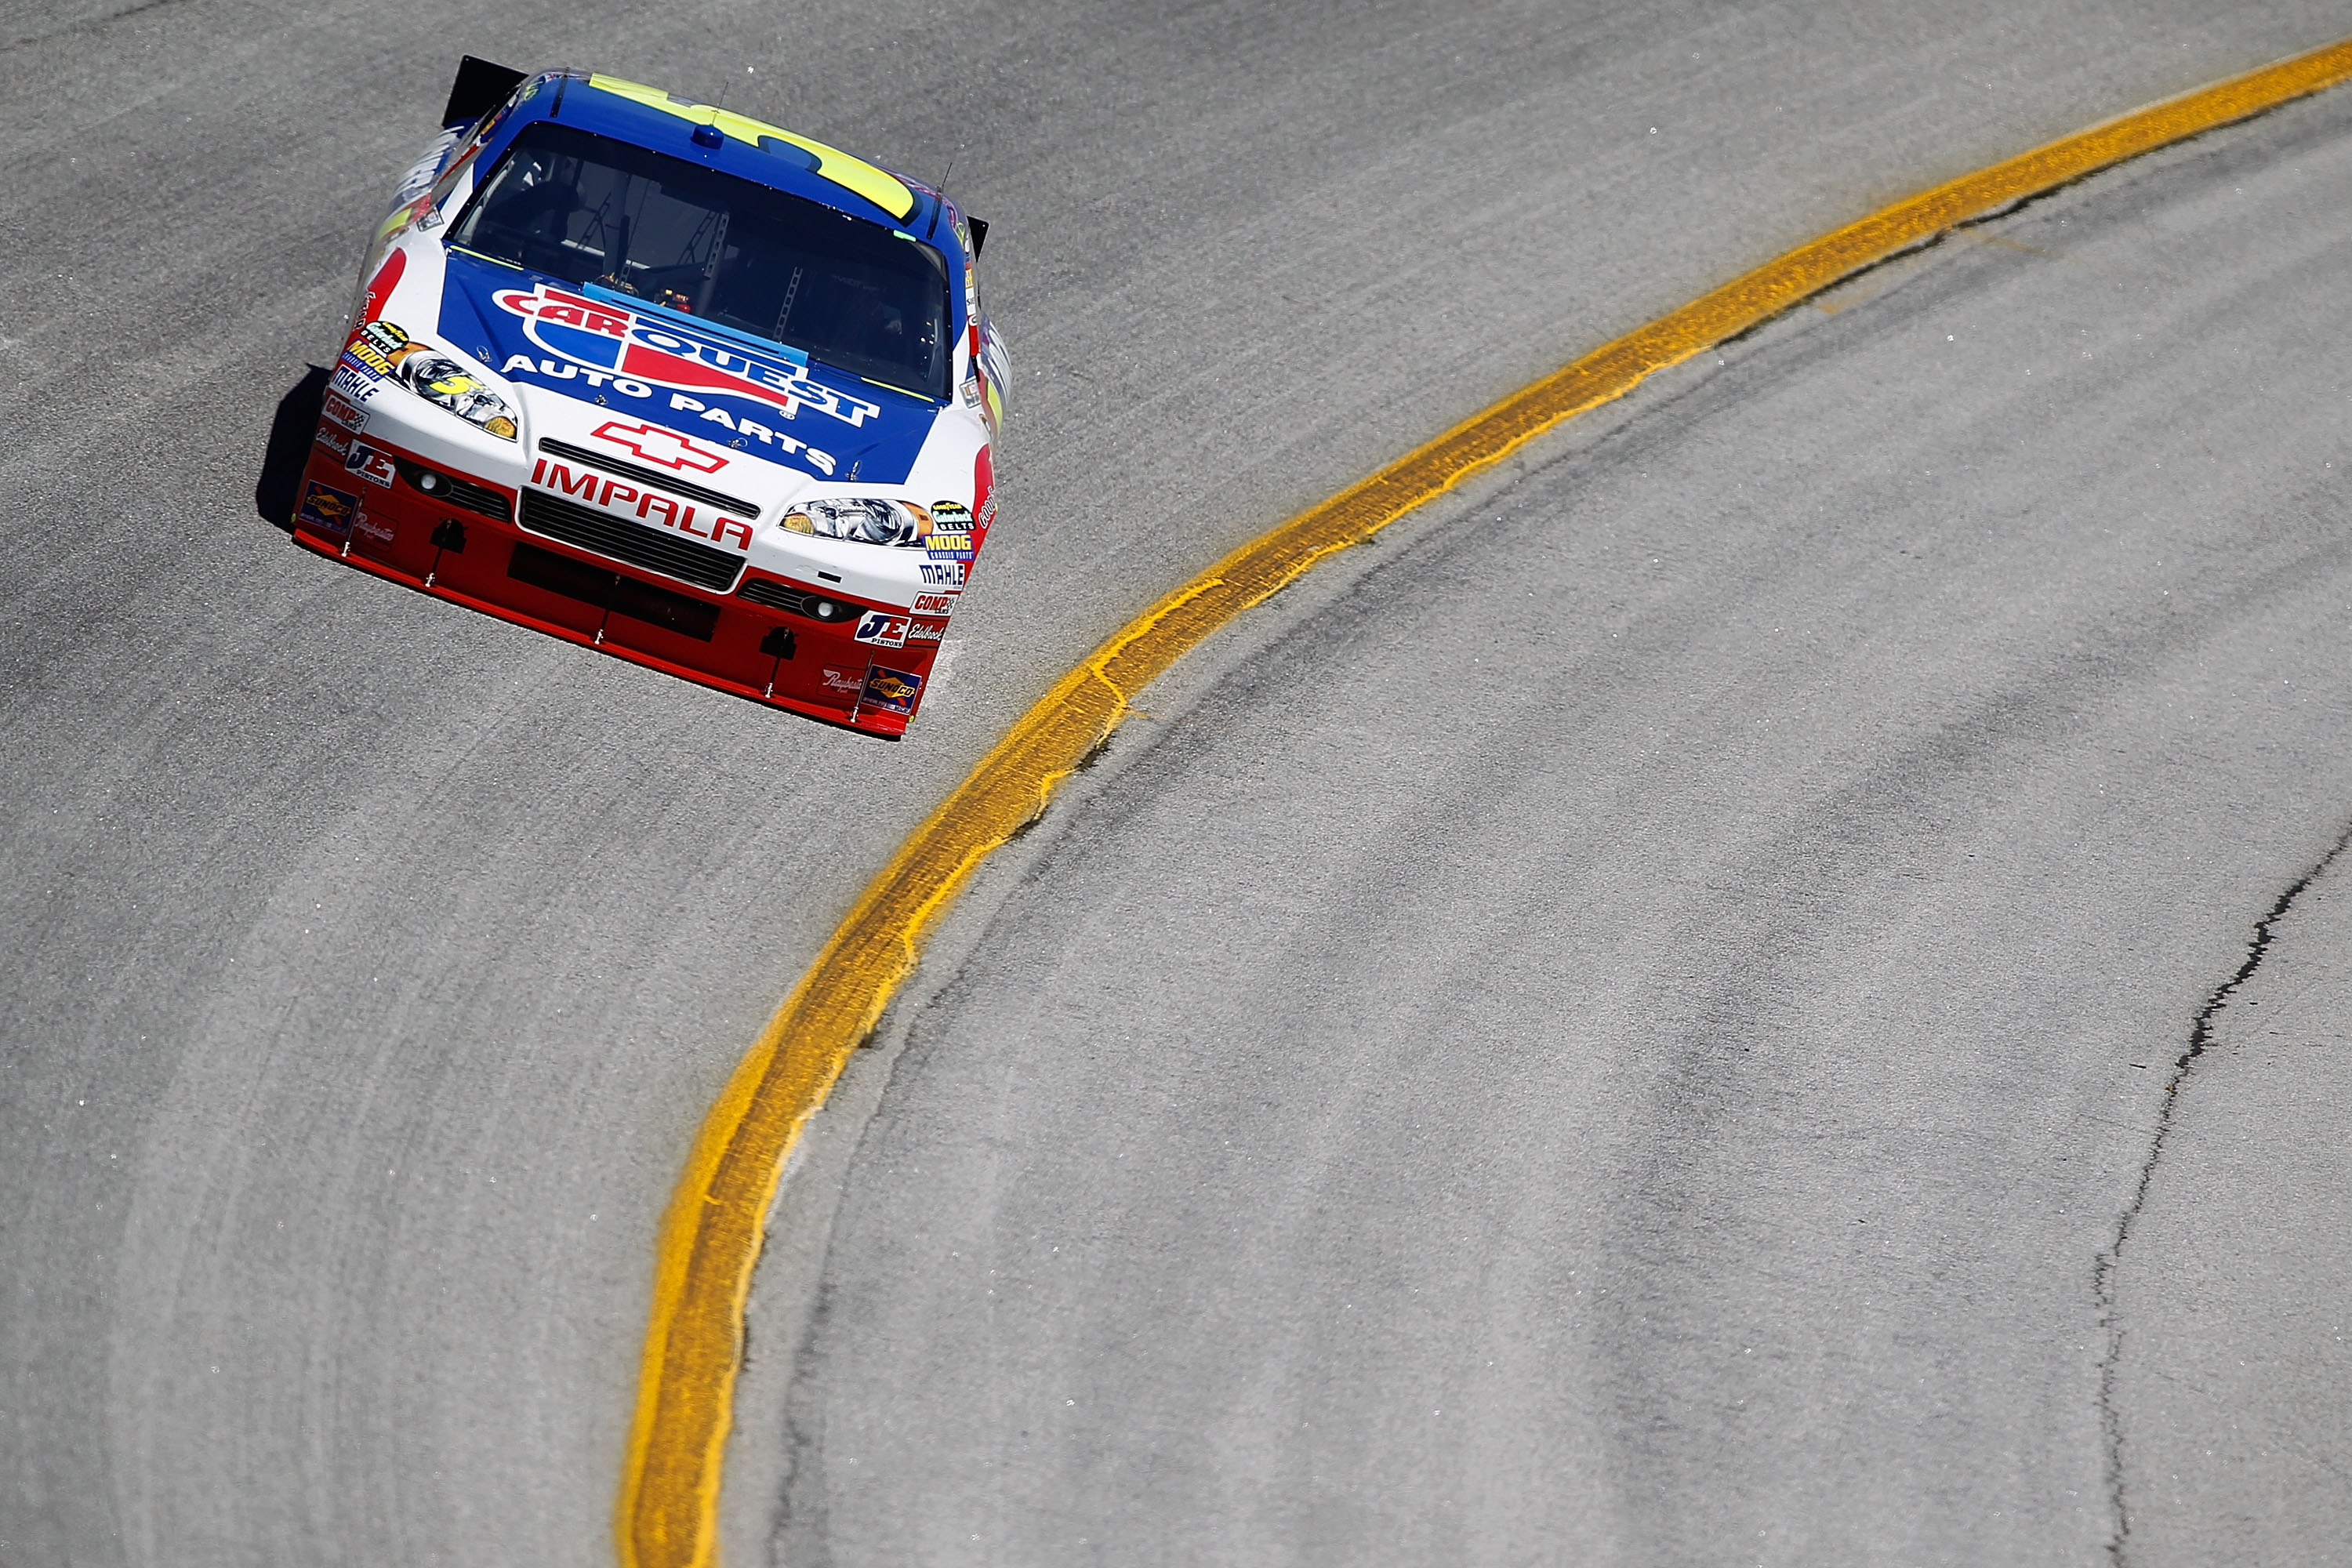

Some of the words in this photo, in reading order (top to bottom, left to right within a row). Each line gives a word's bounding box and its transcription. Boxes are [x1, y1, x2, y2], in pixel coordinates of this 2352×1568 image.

[361, 330, 391, 354] BELTS
[348, 340, 395, 376] MOOG
[330, 367, 379, 403] MAHLE
[429, 376, 484, 395] 5
[326, 397, 357, 421] COMP
[501, 354, 652, 398] AUTO
[670, 394, 837, 476] PARTS
[356, 469, 391, 488] PISTONS
[307, 495, 350, 516] SUNOCO
[531, 458, 753, 551] IMPALA
[925, 535, 972, 551] MOOG
[919, 564, 964, 586] MAHLE
[914, 594, 949, 611] COMP
[871, 637, 903, 648] PISTONS
[870, 679, 914, 697] SUNOCO
